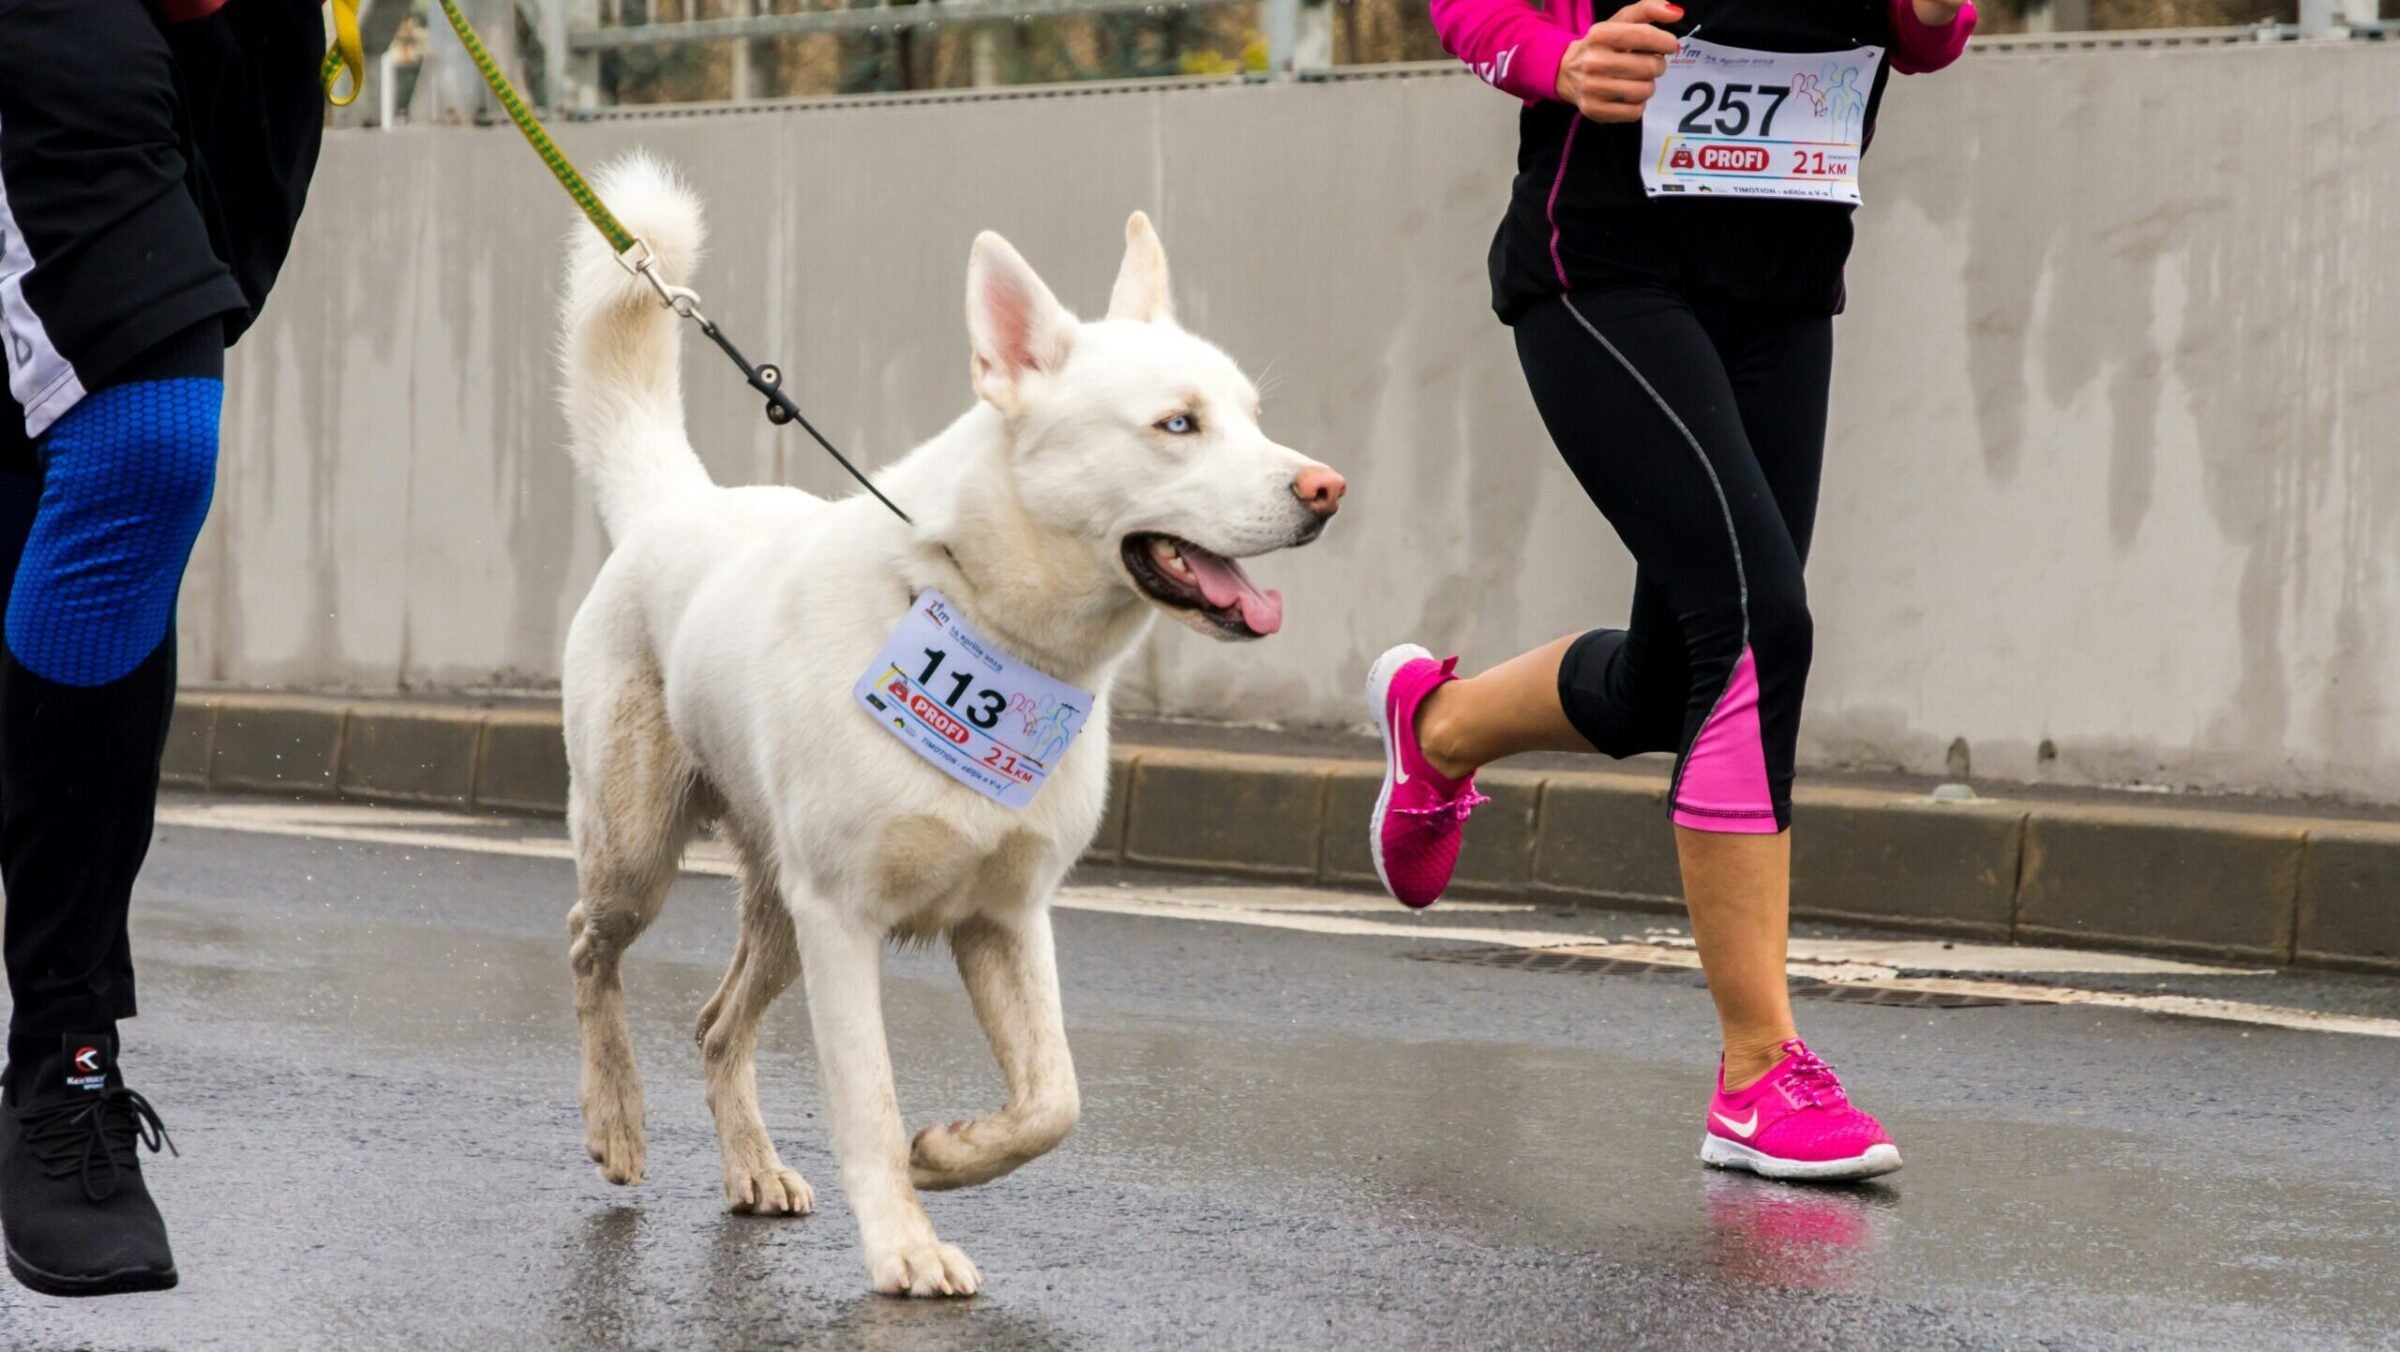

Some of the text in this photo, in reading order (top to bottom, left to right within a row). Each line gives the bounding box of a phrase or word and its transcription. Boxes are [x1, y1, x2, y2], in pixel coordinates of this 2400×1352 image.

[1677, 81, 1791, 137] 257
[1704, 149, 1764, 170] PROFI
[1792, 150, 1848, 176] 21 KM
[1733, 186, 1777, 195] TIMOTION
[917, 646, 1008, 730] 113
[915, 698, 963, 742] PROFI
[920, 736, 958, 766] TIMOTION
[983, 747, 1017, 775] 21
[1013, 768, 1034, 784] KM
